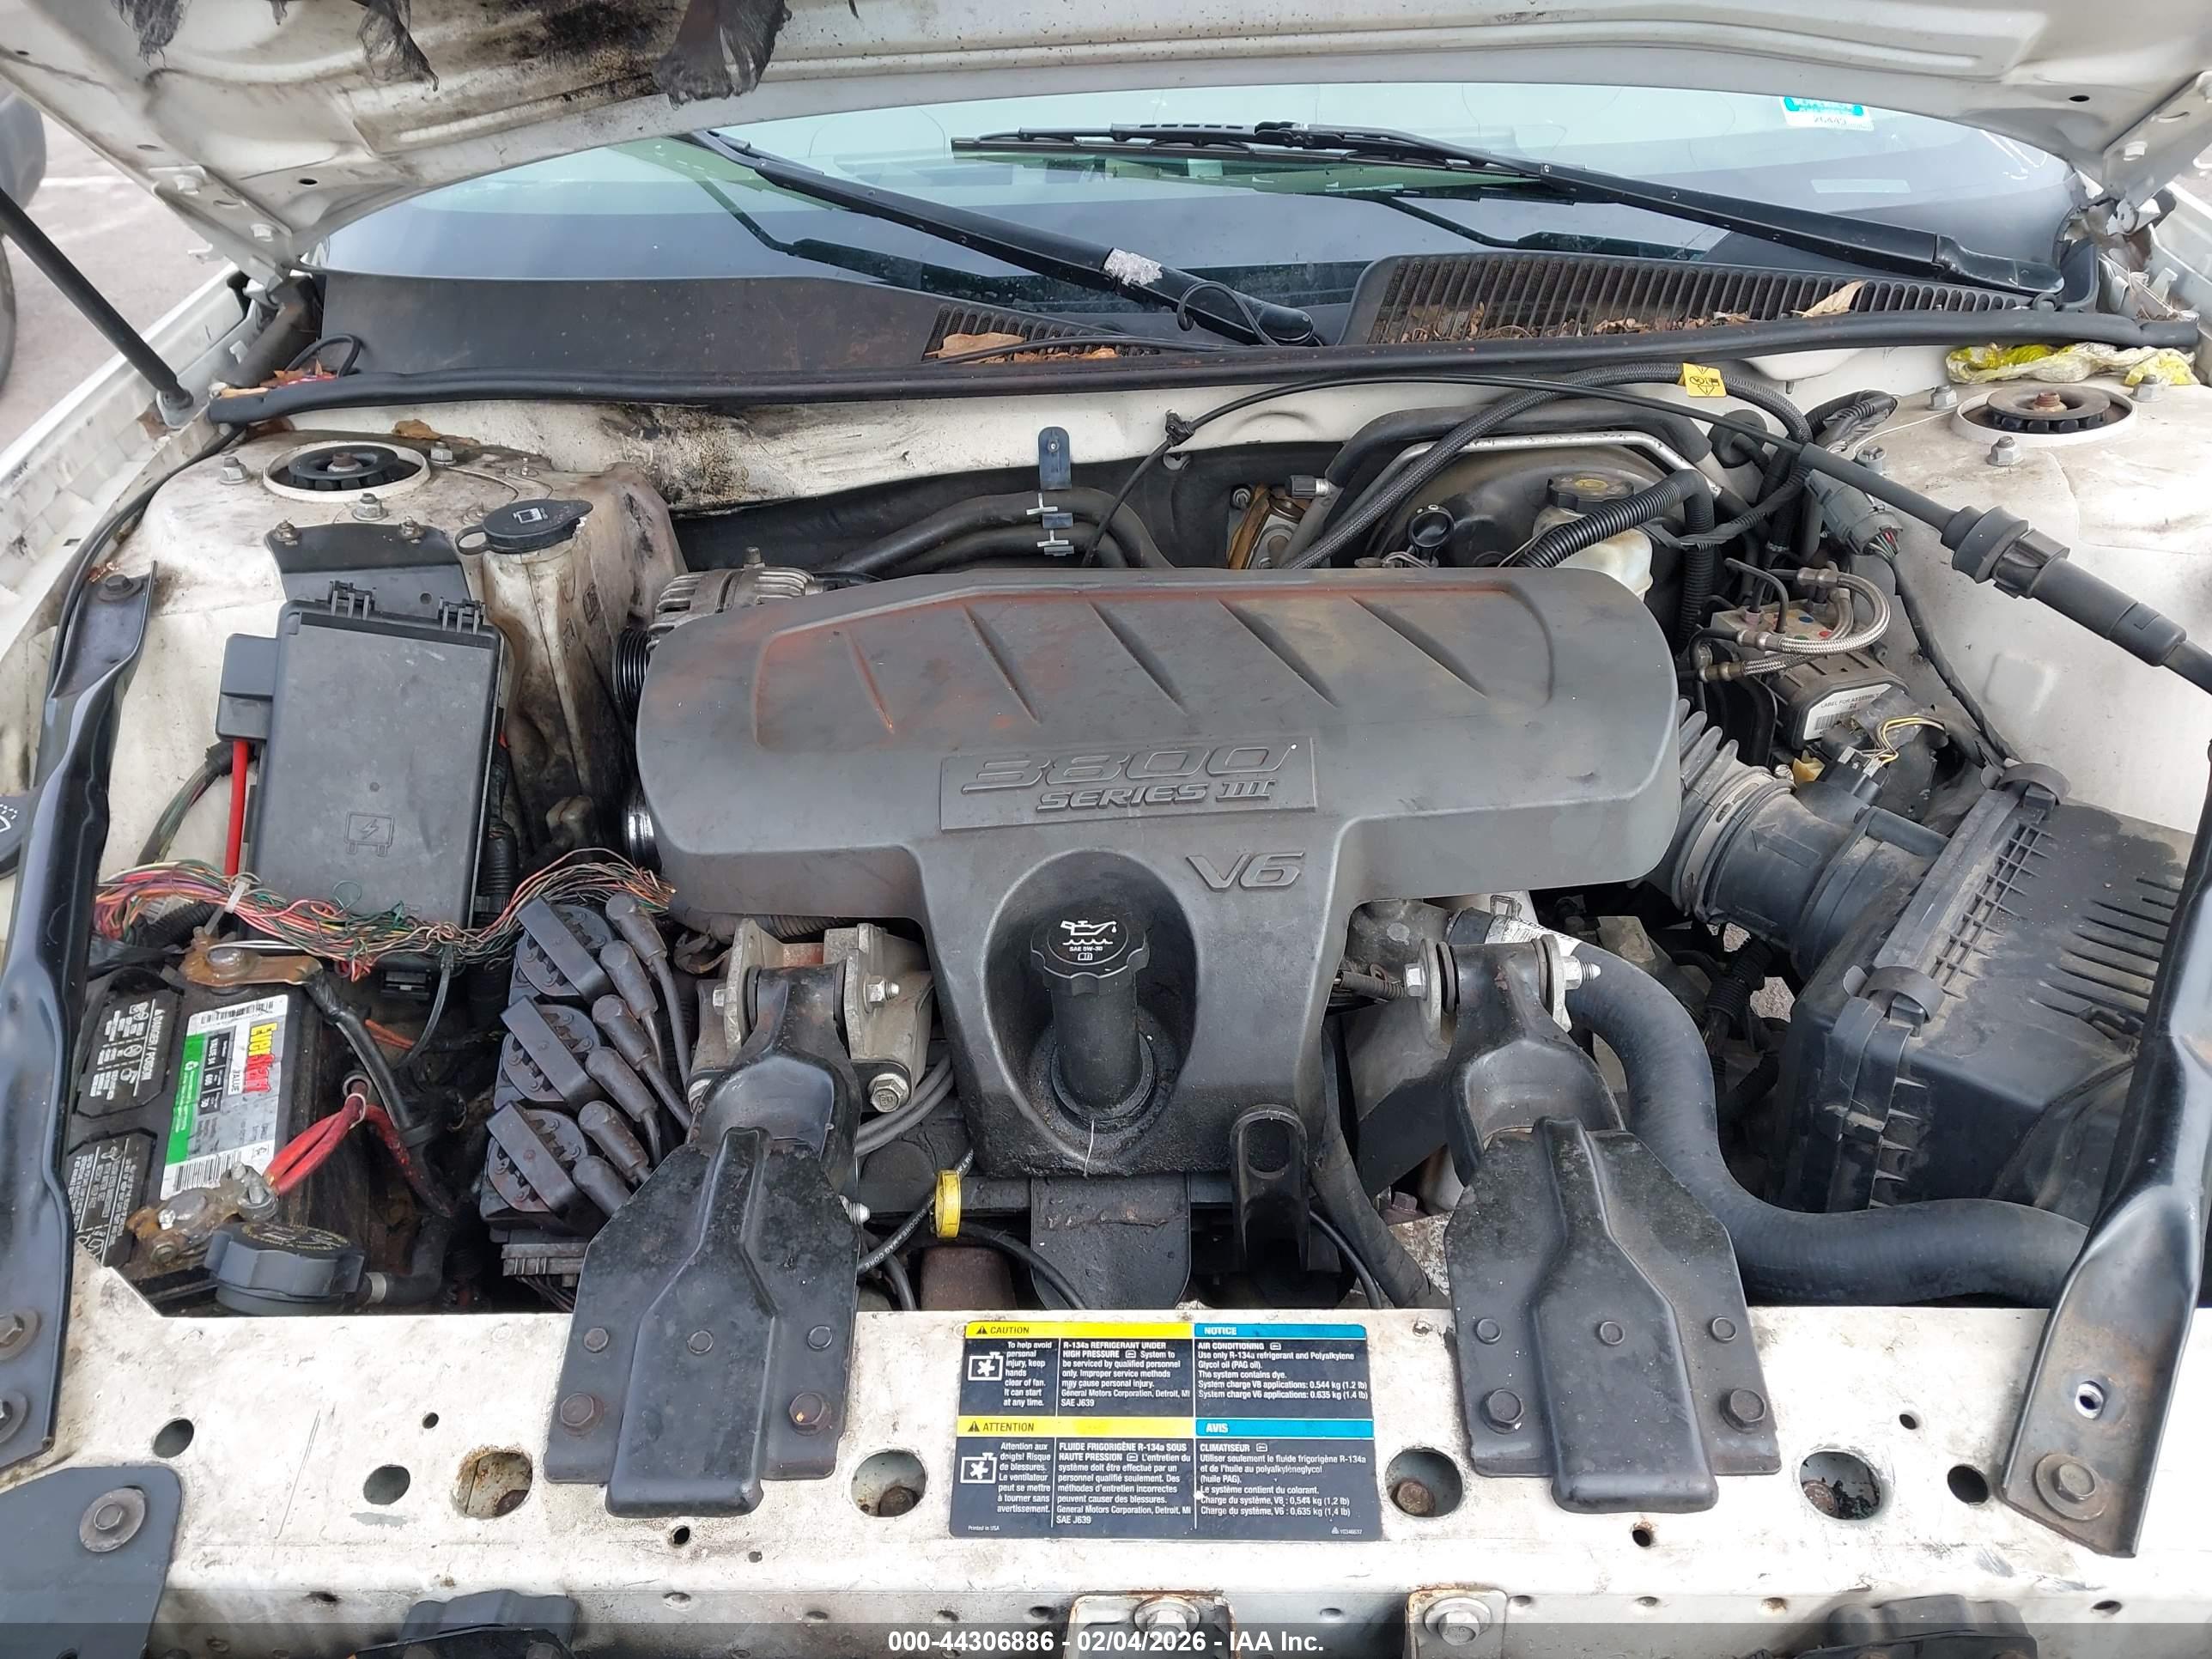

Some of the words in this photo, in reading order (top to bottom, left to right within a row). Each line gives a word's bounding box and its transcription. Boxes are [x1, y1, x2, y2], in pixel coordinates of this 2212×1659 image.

[962, 745, 1297, 793] 3800
[1037, 783, 1208, 812] SERIES
[1215, 779, 1276, 802] III
[1187, 852, 1304, 892] V6
[245, 1022, 278, 1093] EverStart
[902, 1208, 926, 1237] SILICONE
[884, 1240, 899, 1255] MAG
[865, 1253, 885, 1268] CORE
[1205, 1327, 1237, 1335] NOTICE
[1006, 1351, 1036, 1359] personal
[1140, 1351, 1166, 1359] System
[1213, 1352, 1227, 1360] only
[1006, 1359, 1026, 1368] injury,
[1104, 1360, 1112, 1369] by
[1115, 1360, 1144, 1369] qualified
[1146, 1360, 1181, 1369] personnel
[1198, 1361, 1219, 1370] Glycol
[1231, 1361, 1248, 1370] (PAG
[1062, 1370, 1077, 1378] only.
[1080, 1370, 1111, 1378] Improper
[1101, 1380, 1131, 1389] personal
[1133, 1380, 1154, 1389] injury.
[1226, 1391, 1251, 1400] charge
[1263, 1391, 1309, 1400] applications:
[1333, 1391, 1341, 1400] kg
[1358, 1391, 1368, 1400] lb)
[983, 1423, 1034, 1431] ATTENTION
[1206, 1424, 1229, 1432] AVIS
[1087, 1442, 1136, 1451] FRIGORIGÈNE
[1200, 1443, 1250, 1452] CLIMATISEUR
[1000, 1453, 1024, 1462] doigts!
[1027, 1453, 1050, 1462] Risque
[1059, 1463, 1088, 1473] système
[1096, 1474, 1121, 1483] qualifié
[1200, 1475, 1220, 1484] (huile
[1222, 1475, 1241, 1484] PAG).
[1212, 1486, 1243, 1495] système
[1244, 1486, 1273, 1494] contient
[1057, 1495, 1086, 1504] peuvent
[1111, 1506, 1153, 1515] Corporation,
